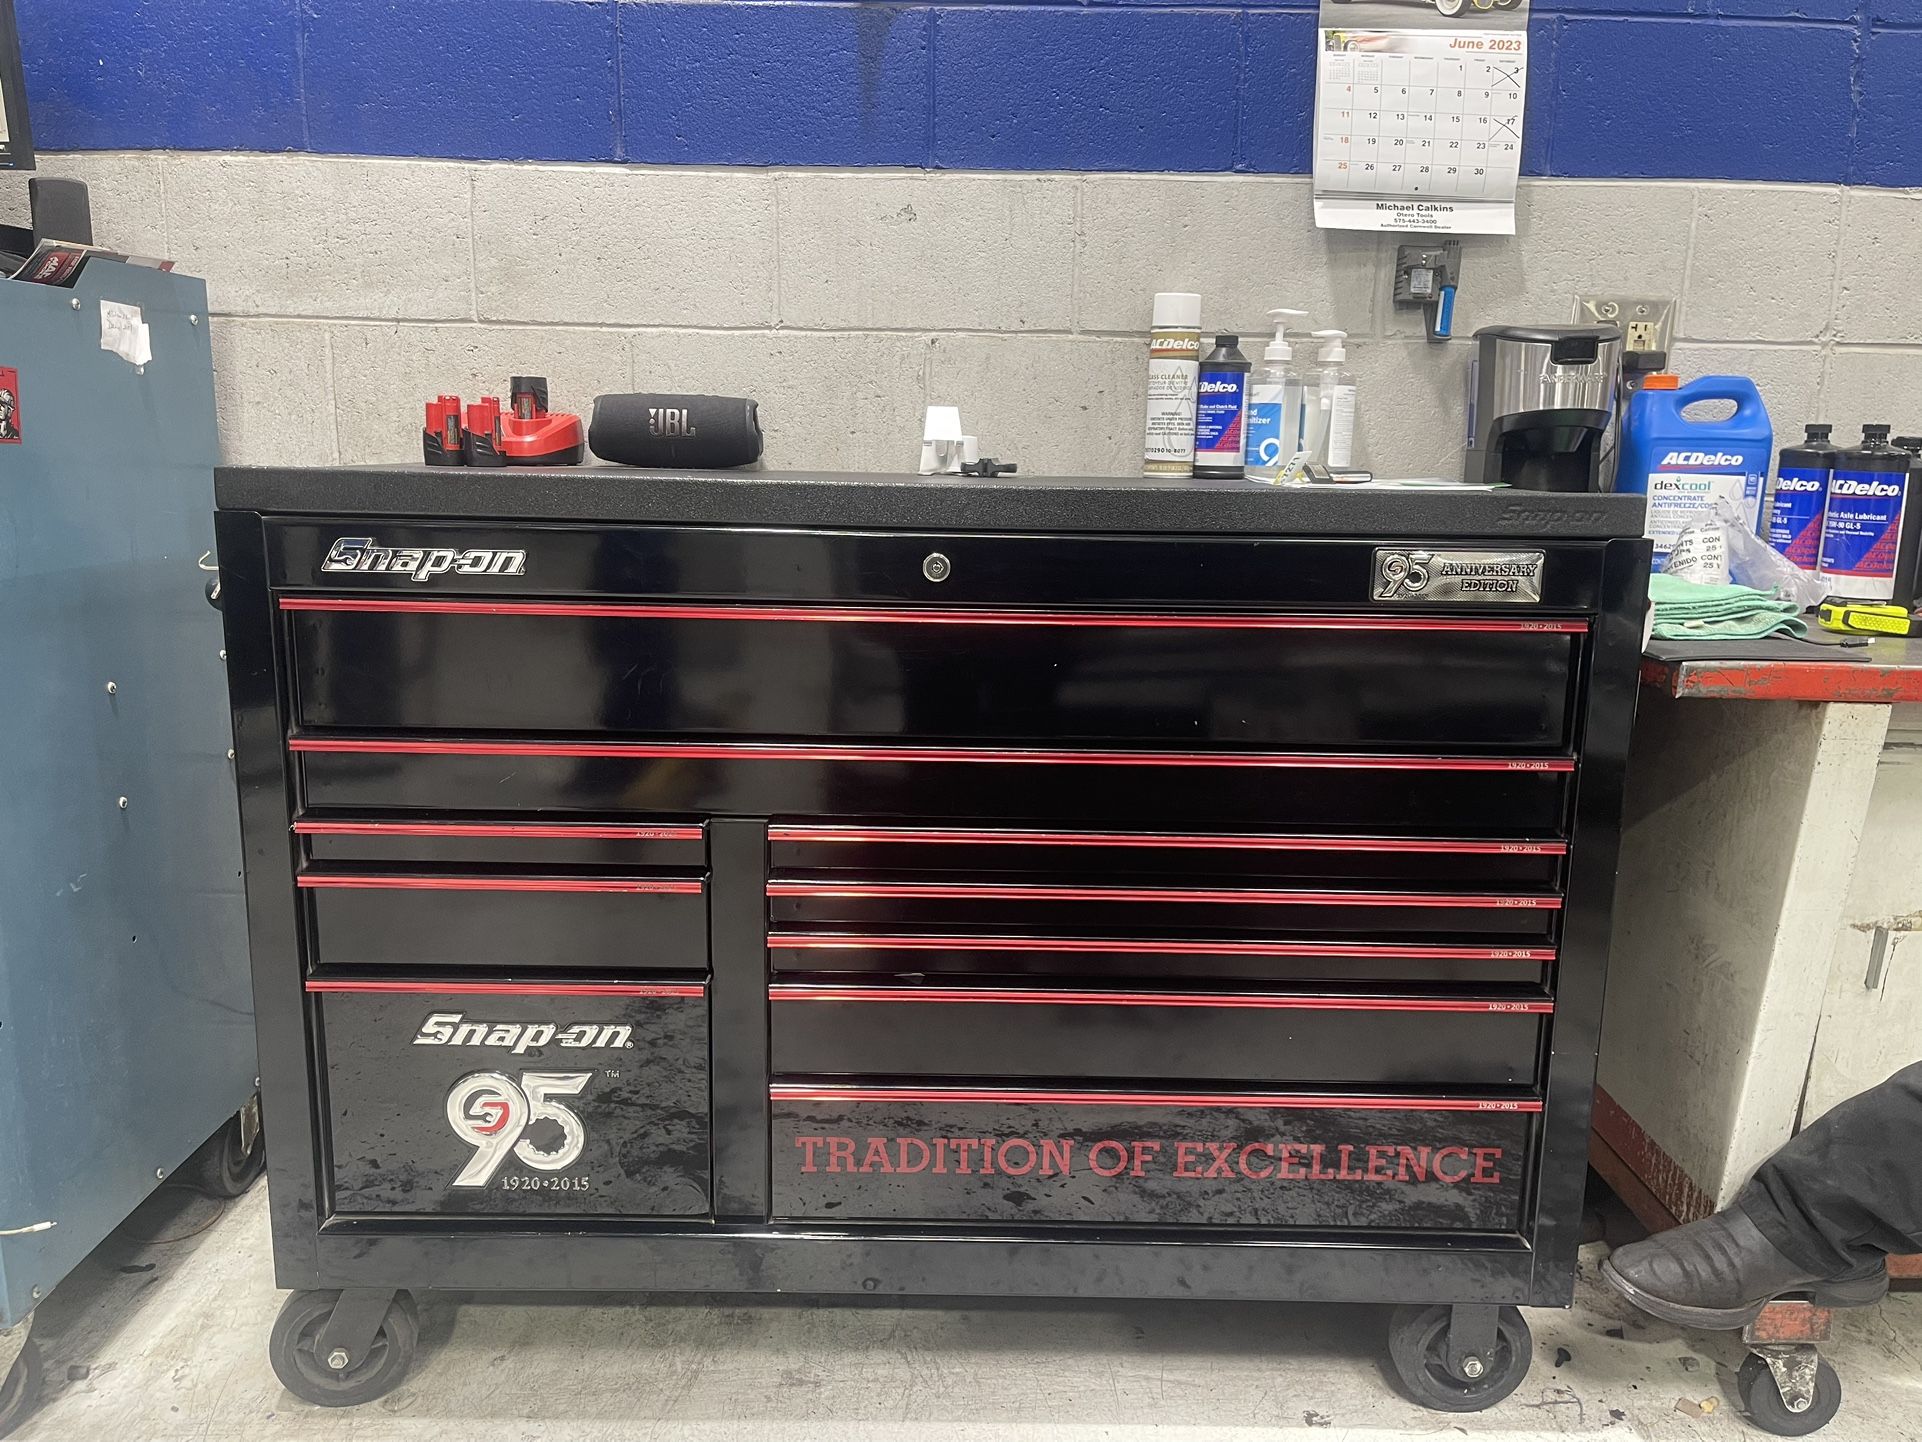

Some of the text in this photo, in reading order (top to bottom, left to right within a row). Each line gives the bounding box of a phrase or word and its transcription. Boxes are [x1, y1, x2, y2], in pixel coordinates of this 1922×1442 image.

[1449, 38, 1522, 51] June 2023
[1341, 111, 1350, 119] 11
[1479, 117, 1488, 125] 16
[1507, 118, 1516, 126] 17
[1449, 141, 1459, 149] 22
[1474, 168, 1484, 176] 30
[1376, 203, 1454, 213] Michael Calkins
[1199, 381, 1237, 392] Delco
[649, 408, 696, 438] JBL
[1661, 452, 1743, 466] ACDelco
[1654, 481, 1711, 491] dexcool
[1855, 513, 1887, 521] Lubricant
[321, 537, 526, 581] Snap-on
[1379, 551, 1434, 597] 95
[1441, 563, 1538, 576] ANNIVERSARY
[1461, 580, 1518, 592] EDITION
[413, 1013, 633, 1054] Snap-on
[447, 1072, 593, 1186] 95
[795, 1136, 1503, 1184] TRADITION OF EXCELLENCE
[502, 1176, 590, 1191] 1920•2015
